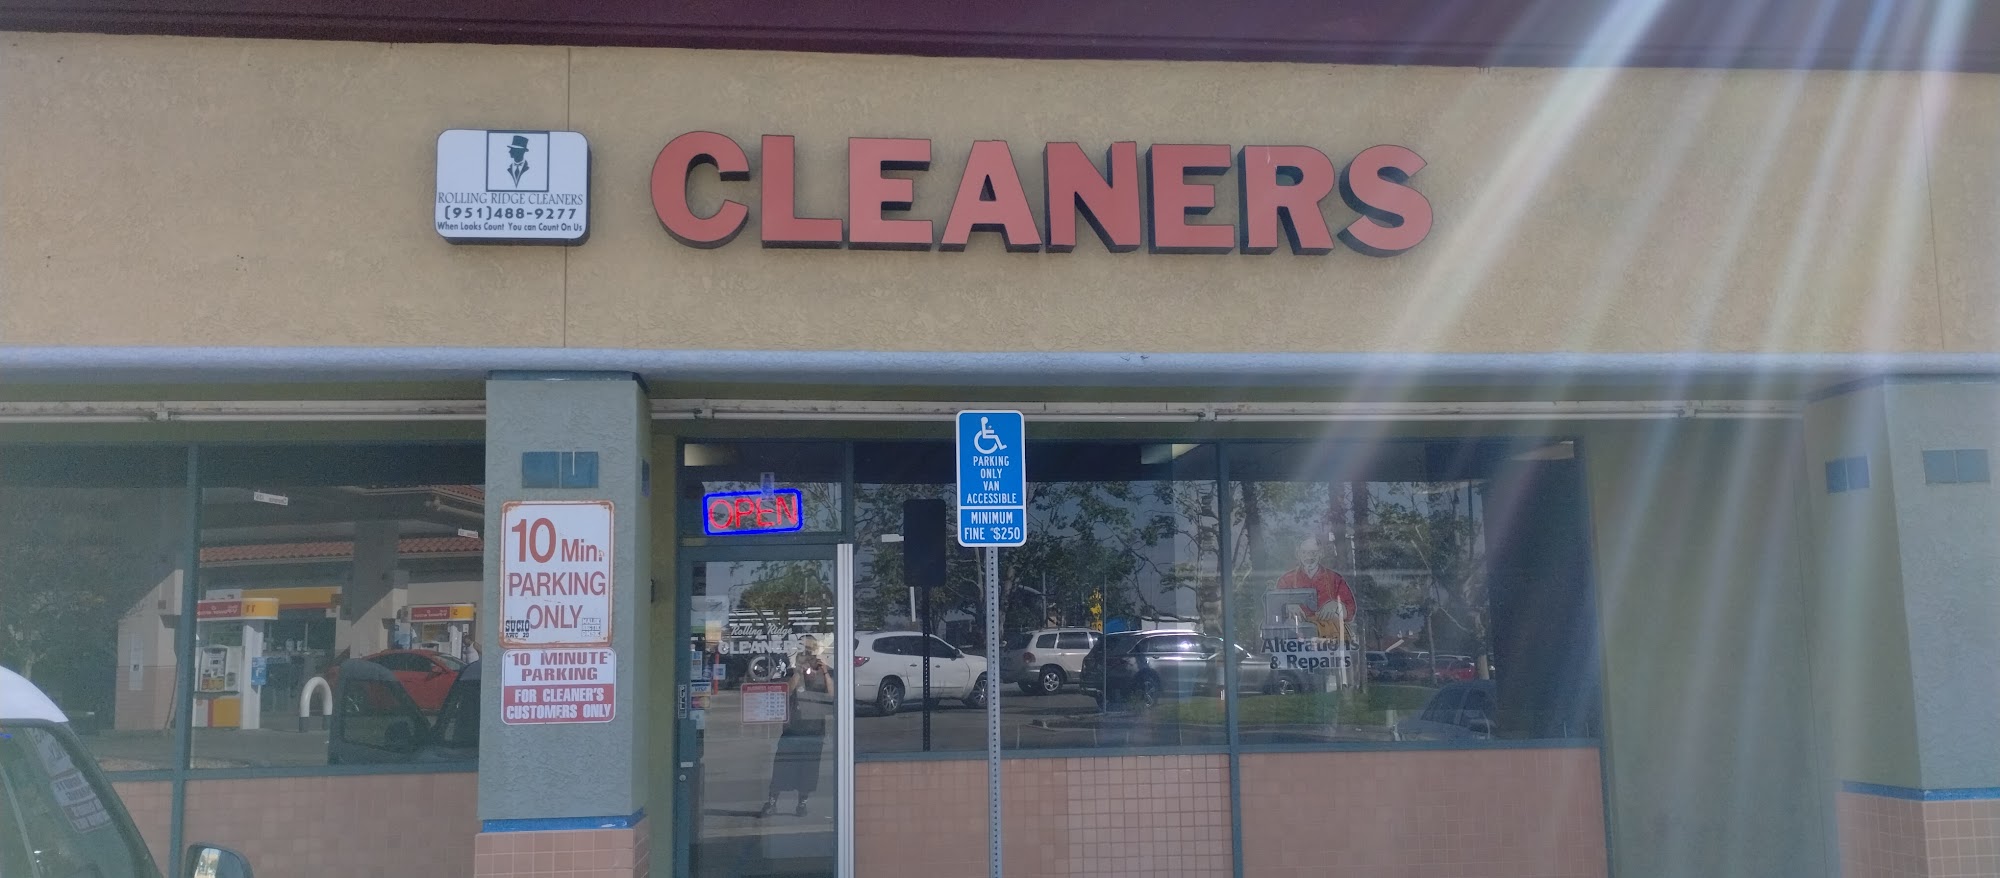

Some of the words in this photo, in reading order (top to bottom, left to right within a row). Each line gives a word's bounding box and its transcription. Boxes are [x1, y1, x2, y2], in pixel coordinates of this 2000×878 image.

[438, 192, 488, 204] ROLLING
[491, 193, 525, 205] RIDGE
[528, 193, 584, 206] CLEANERS
[650, 130, 1434, 256] CLEANERS
[445, 205, 577, 220] (951)488-9277
[437, 221, 458, 231] When
[460, 221, 482, 231] Looks
[483, 222, 505, 231] Count
[507, 222, 522, 231] You
[538, 222, 559, 232] Count
[560, 223, 572, 232] On
[573, 223, 583, 232] Us
[973, 455, 1010, 467] PARKING
[980, 468, 1003, 479] ONLY
[983, 481, 1000, 491] VAN
[966, 493, 1017, 504] ACCESSIBLE
[708, 494, 798, 530] OPEN
[971, 511, 1013, 525] MINIMUM
[511, 517, 557, 564] 10
[964, 527, 985, 541] FINE
[993, 526, 1020, 541] $250
[508, 571, 606, 597] PARKING
[526, 604, 584, 630] ONLY
[505, 619, 530, 633] SUCIO
[731, 624, 763, 638] Rolling
[767, 623, 793, 638] Ridge
[718, 640, 806, 654] CLEANERS
[512, 652, 531, 666] 10
[540, 651, 608, 666] MINUTE
[1269, 655, 1280, 670] &
[1286, 652, 1351, 673] Repairs
[521, 667, 598, 682] PARKING
[515, 688, 537, 703] FOR
[542, 687, 605, 703] CLEANER'S
[506, 704, 578, 720] CUSTOMERS
[583, 703, 612, 718] ONLY
